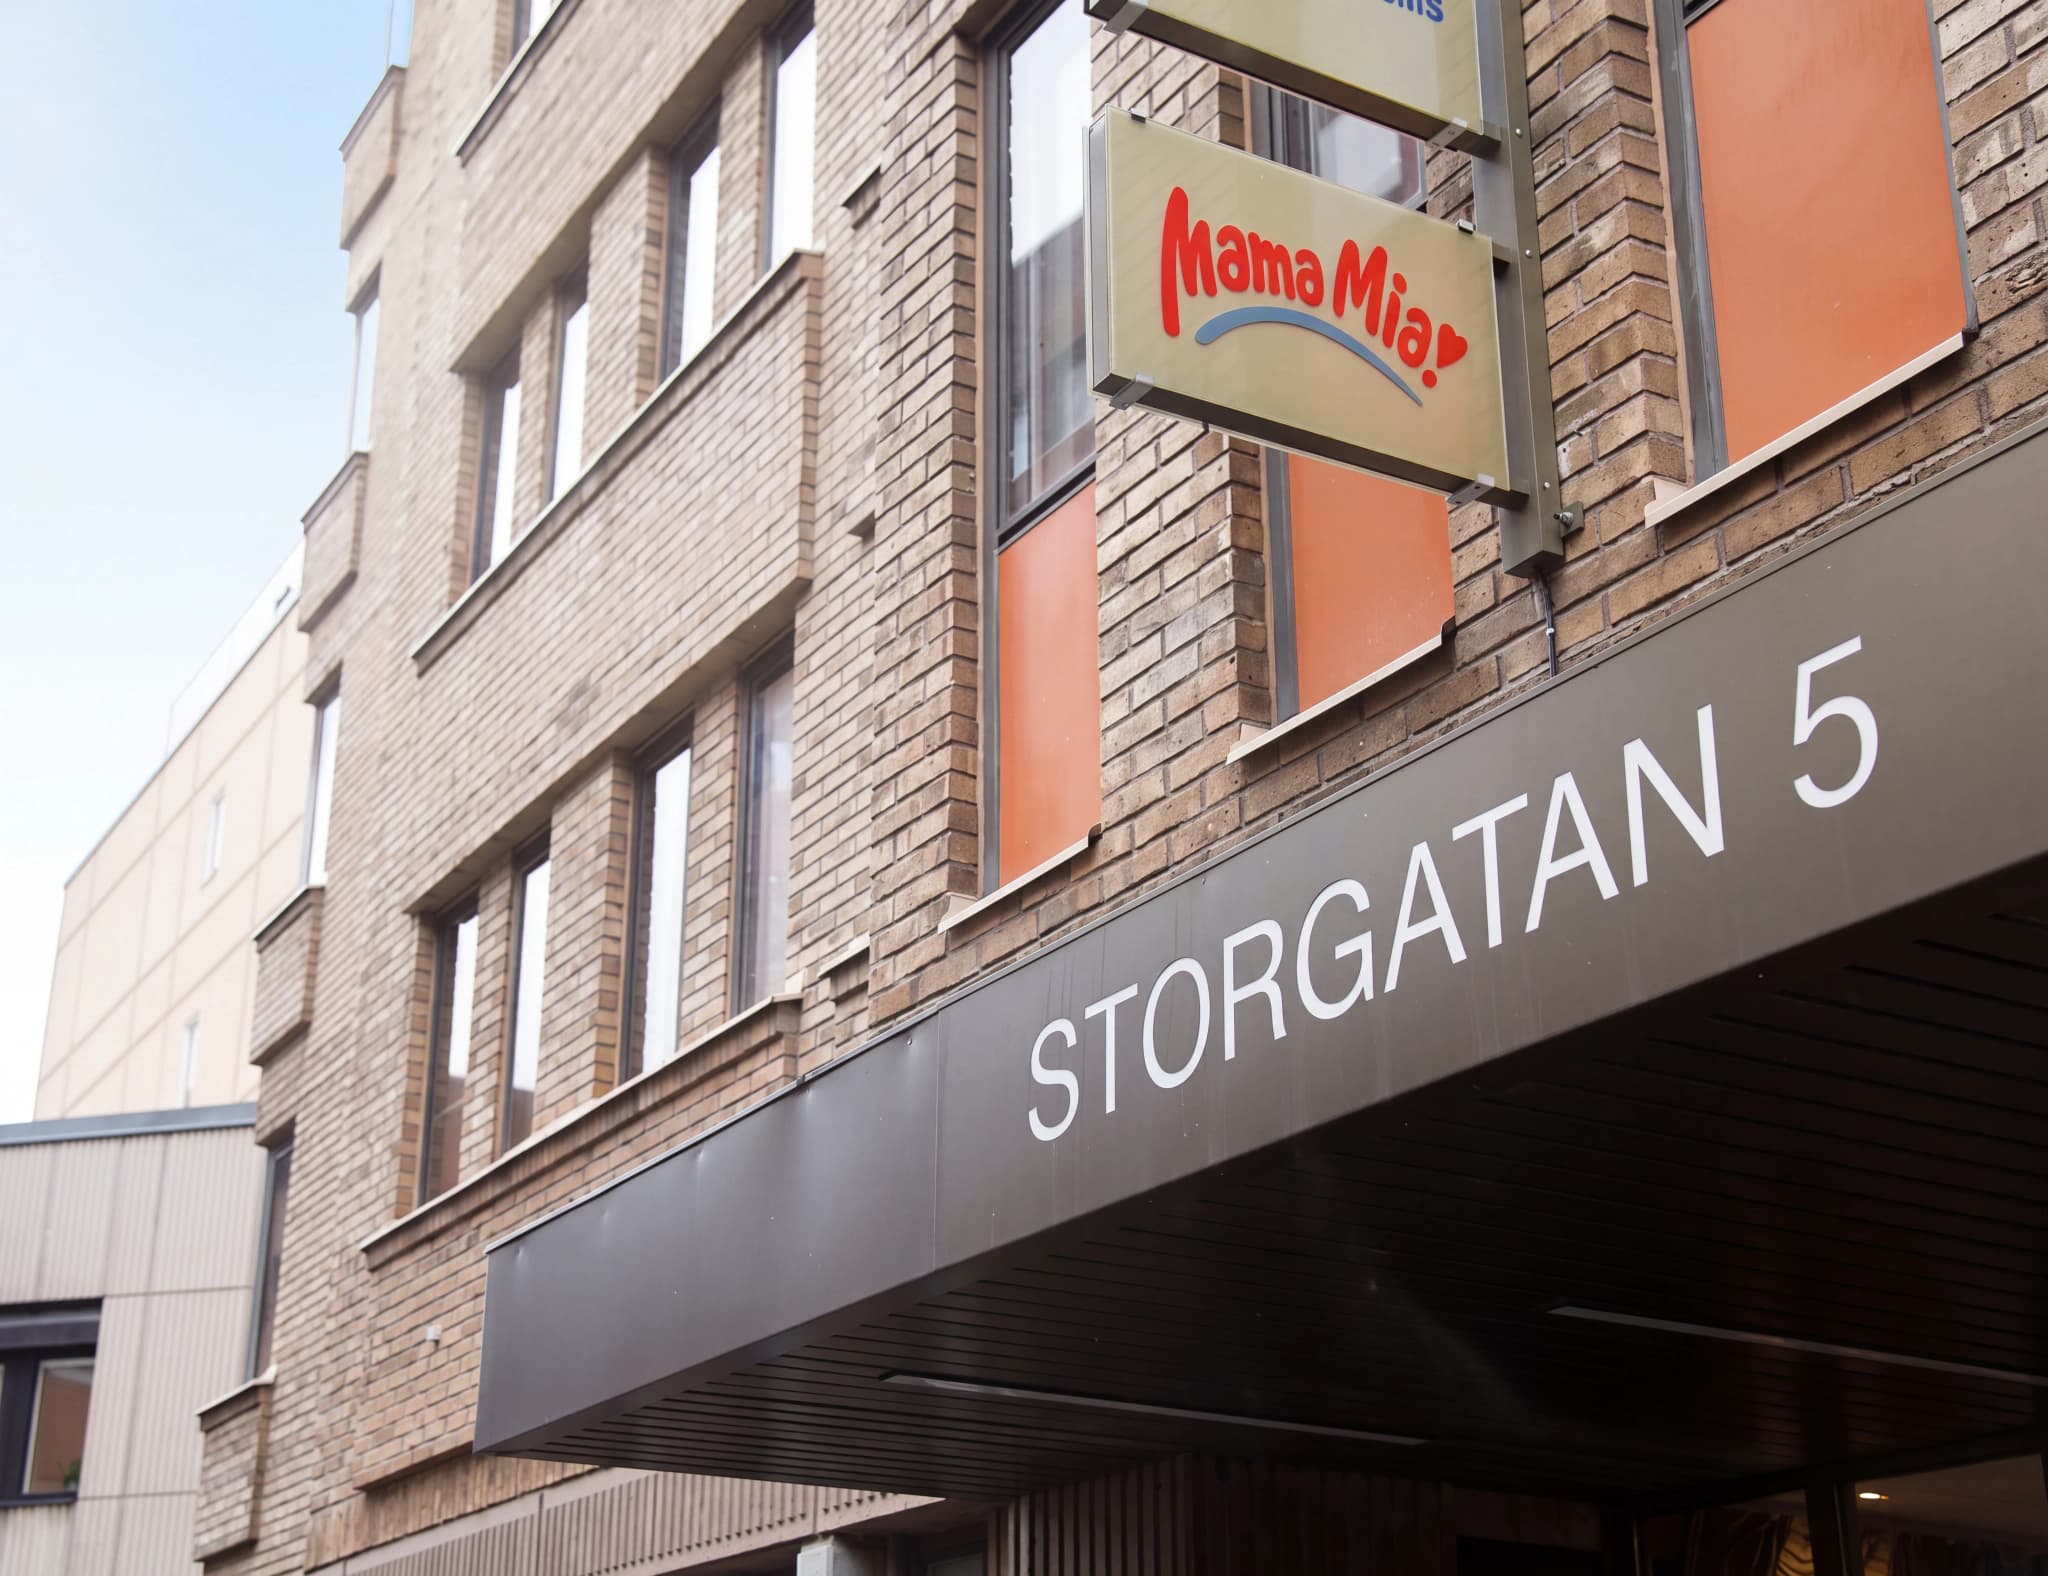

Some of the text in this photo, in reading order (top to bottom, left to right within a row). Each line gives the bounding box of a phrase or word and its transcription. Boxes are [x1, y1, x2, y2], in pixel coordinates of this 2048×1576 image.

[1160, 186, 1325, 337] Mama
[1028, 635, 1878, 1142] STORGATAN 5
